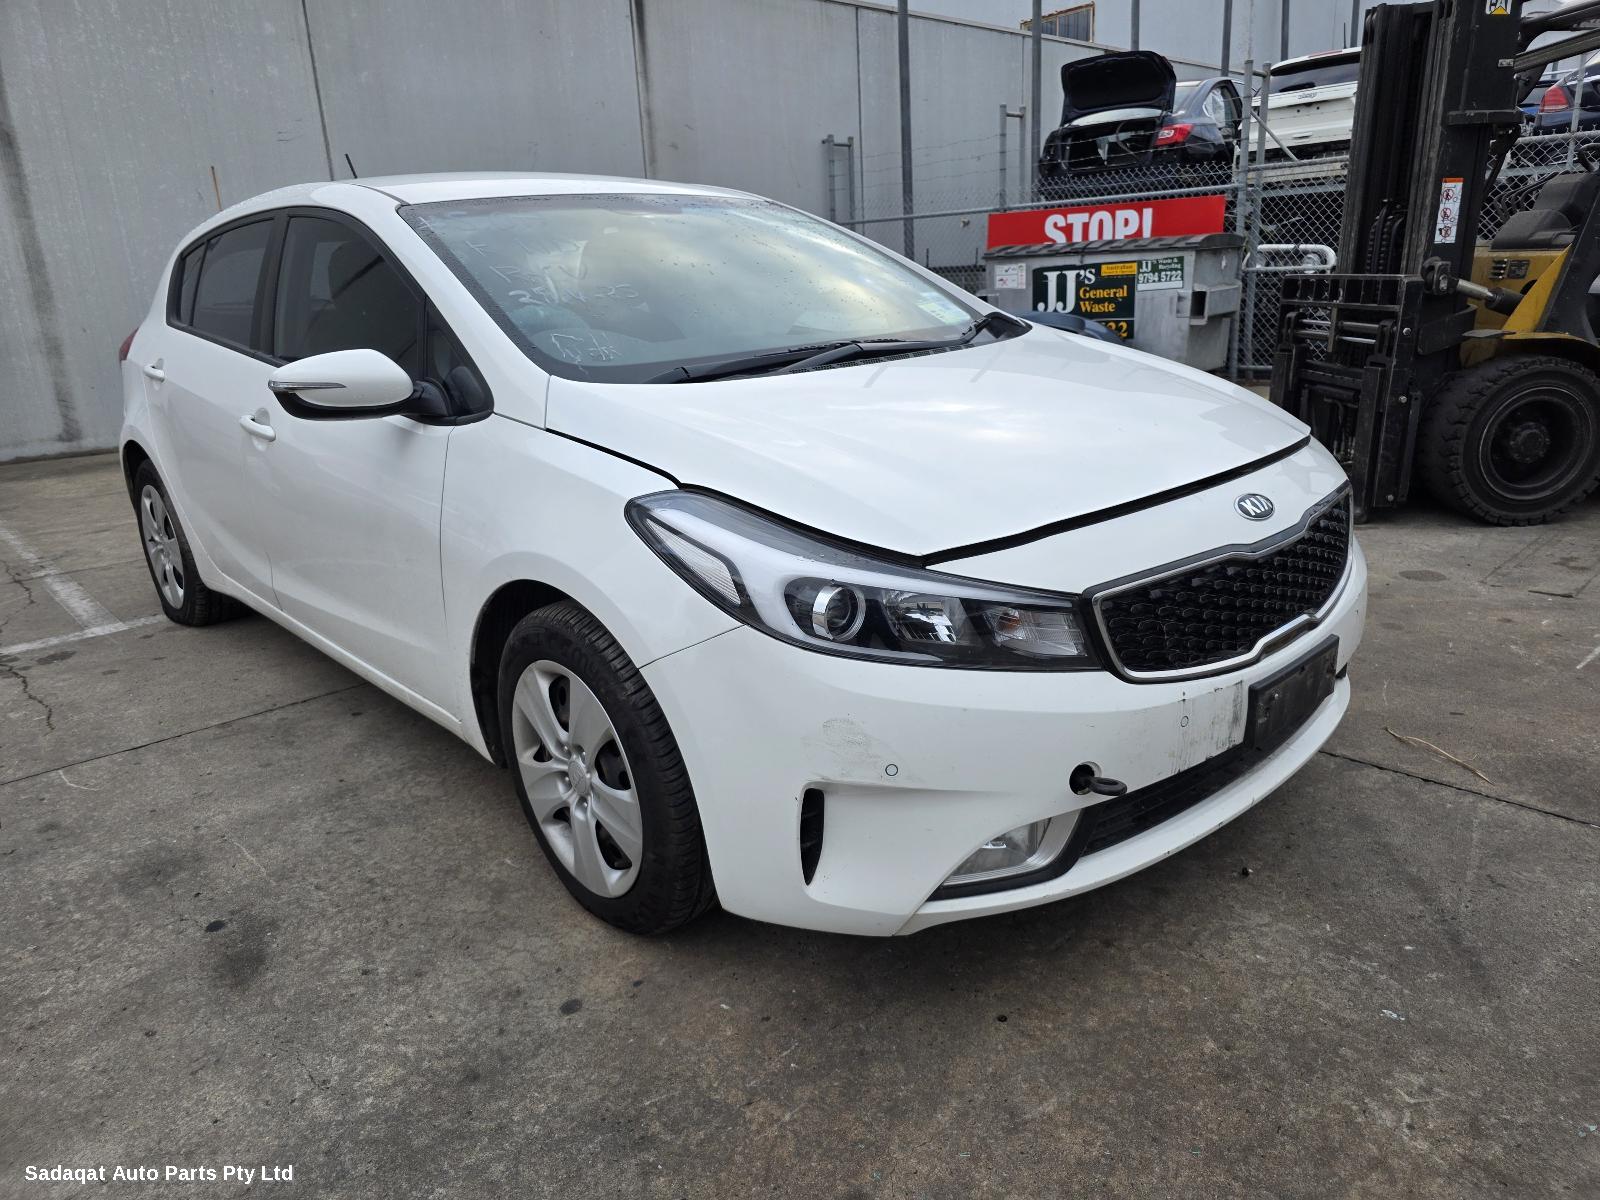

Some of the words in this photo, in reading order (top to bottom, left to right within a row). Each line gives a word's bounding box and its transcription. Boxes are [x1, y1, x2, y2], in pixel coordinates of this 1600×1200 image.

[1044, 208, 1153, 244] STOP!
[1138, 272, 1159, 283] 9794
[1160, 270, 1182, 282] 5722
[1079, 285, 1128, 299] General
[1079, 301, 1116, 313] Waste
